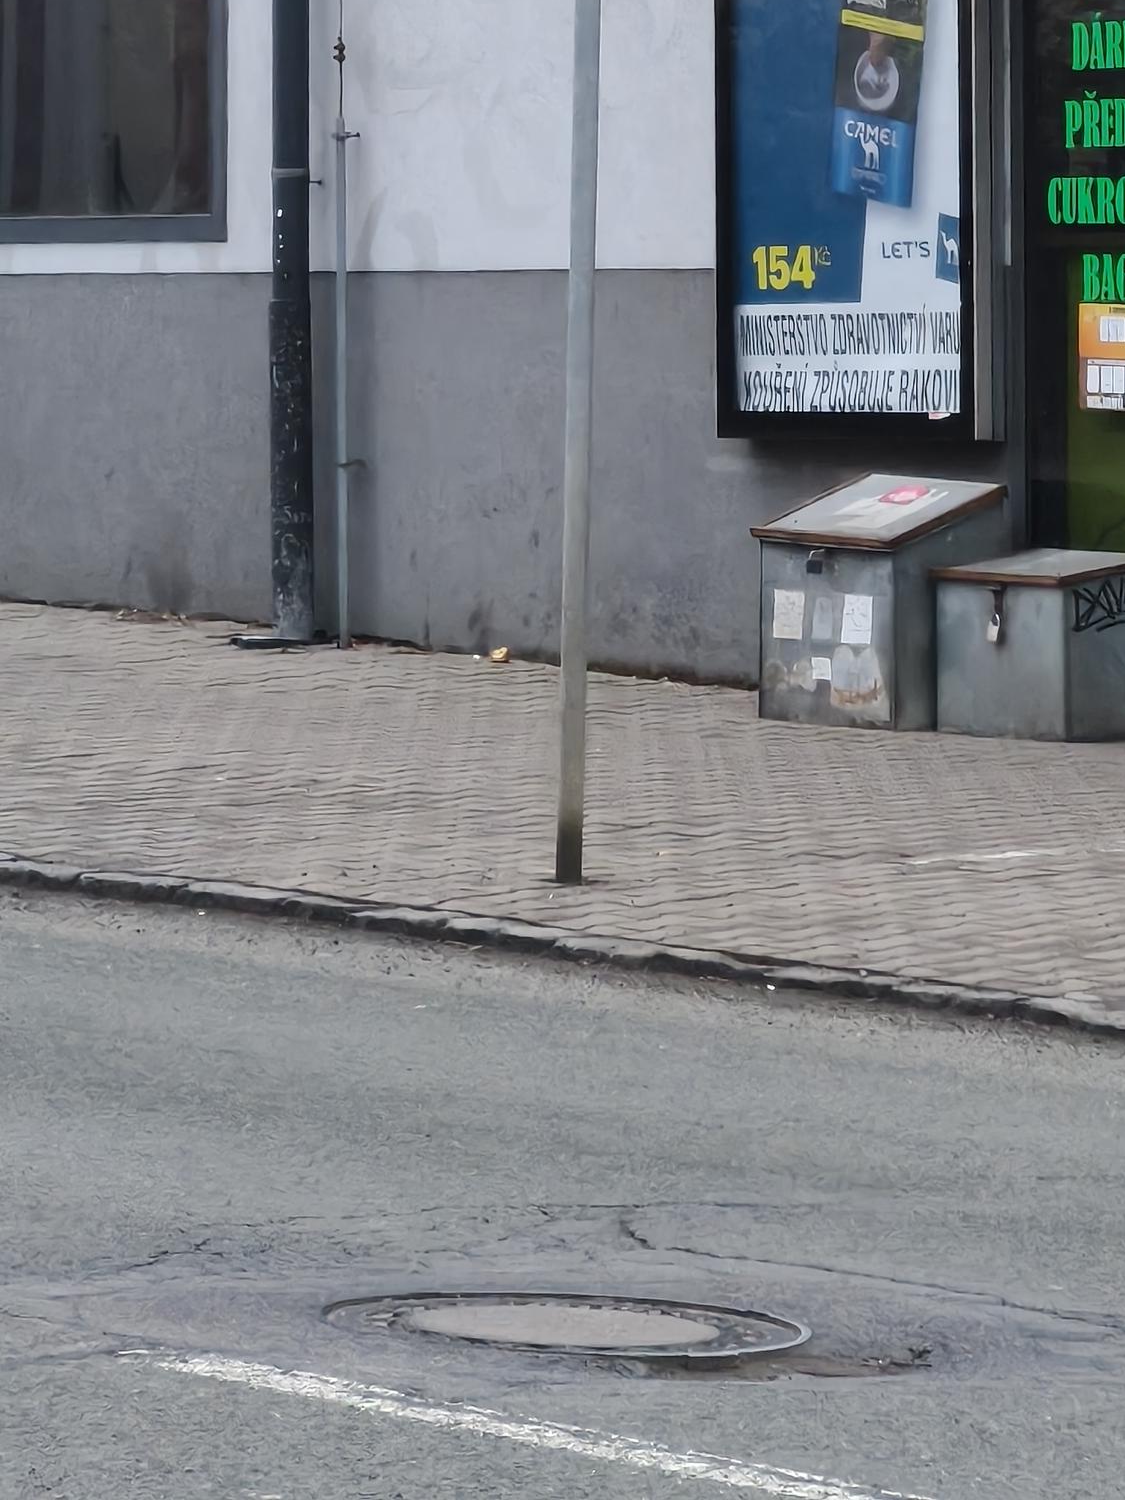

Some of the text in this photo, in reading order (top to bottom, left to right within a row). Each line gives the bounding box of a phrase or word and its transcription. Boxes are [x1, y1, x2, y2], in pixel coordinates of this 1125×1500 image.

[844, 119, 898, 149] CAMEL
[752, 244, 816, 291] 154
[881, 240, 930, 259] LET'S
[739, 313, 828, 357] MINISTERSTVO
[830, 303, 926, 356] ZDRAVOTNICTVÍ
[743, 362, 810, 411] KOUŘENÍ
